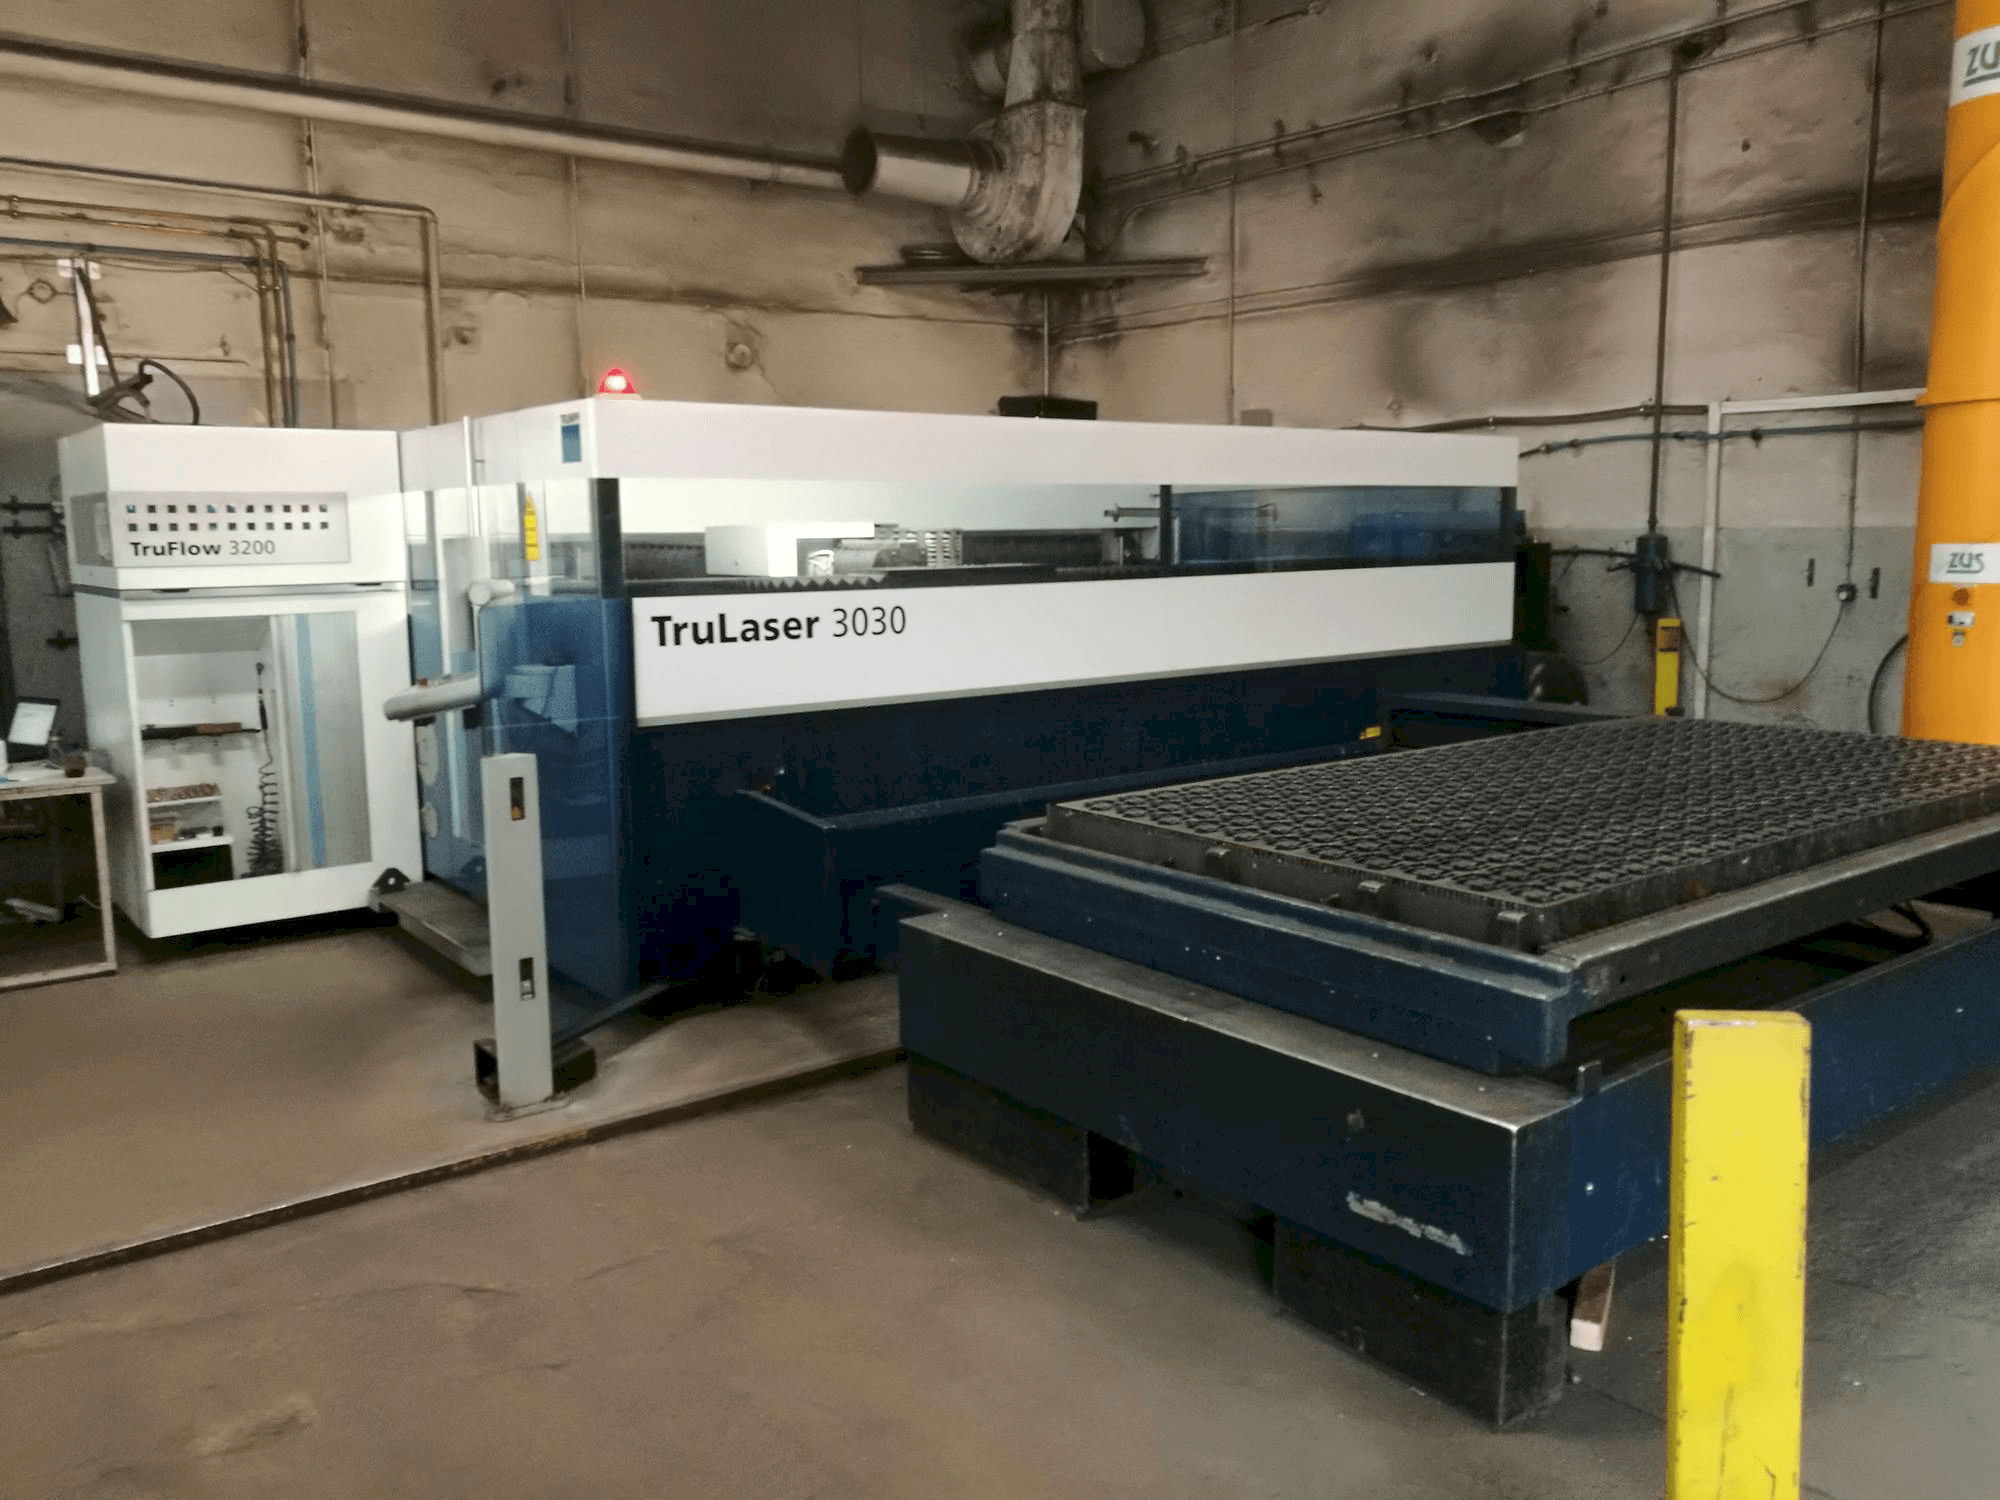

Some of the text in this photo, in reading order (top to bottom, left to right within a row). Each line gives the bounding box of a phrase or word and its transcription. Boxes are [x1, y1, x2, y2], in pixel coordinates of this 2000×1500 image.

[1964, 40, 2000, 87] ZU
[130, 540, 275, 556] TruFlow 3200
[651, 606, 906, 647] TruLaser 3030
